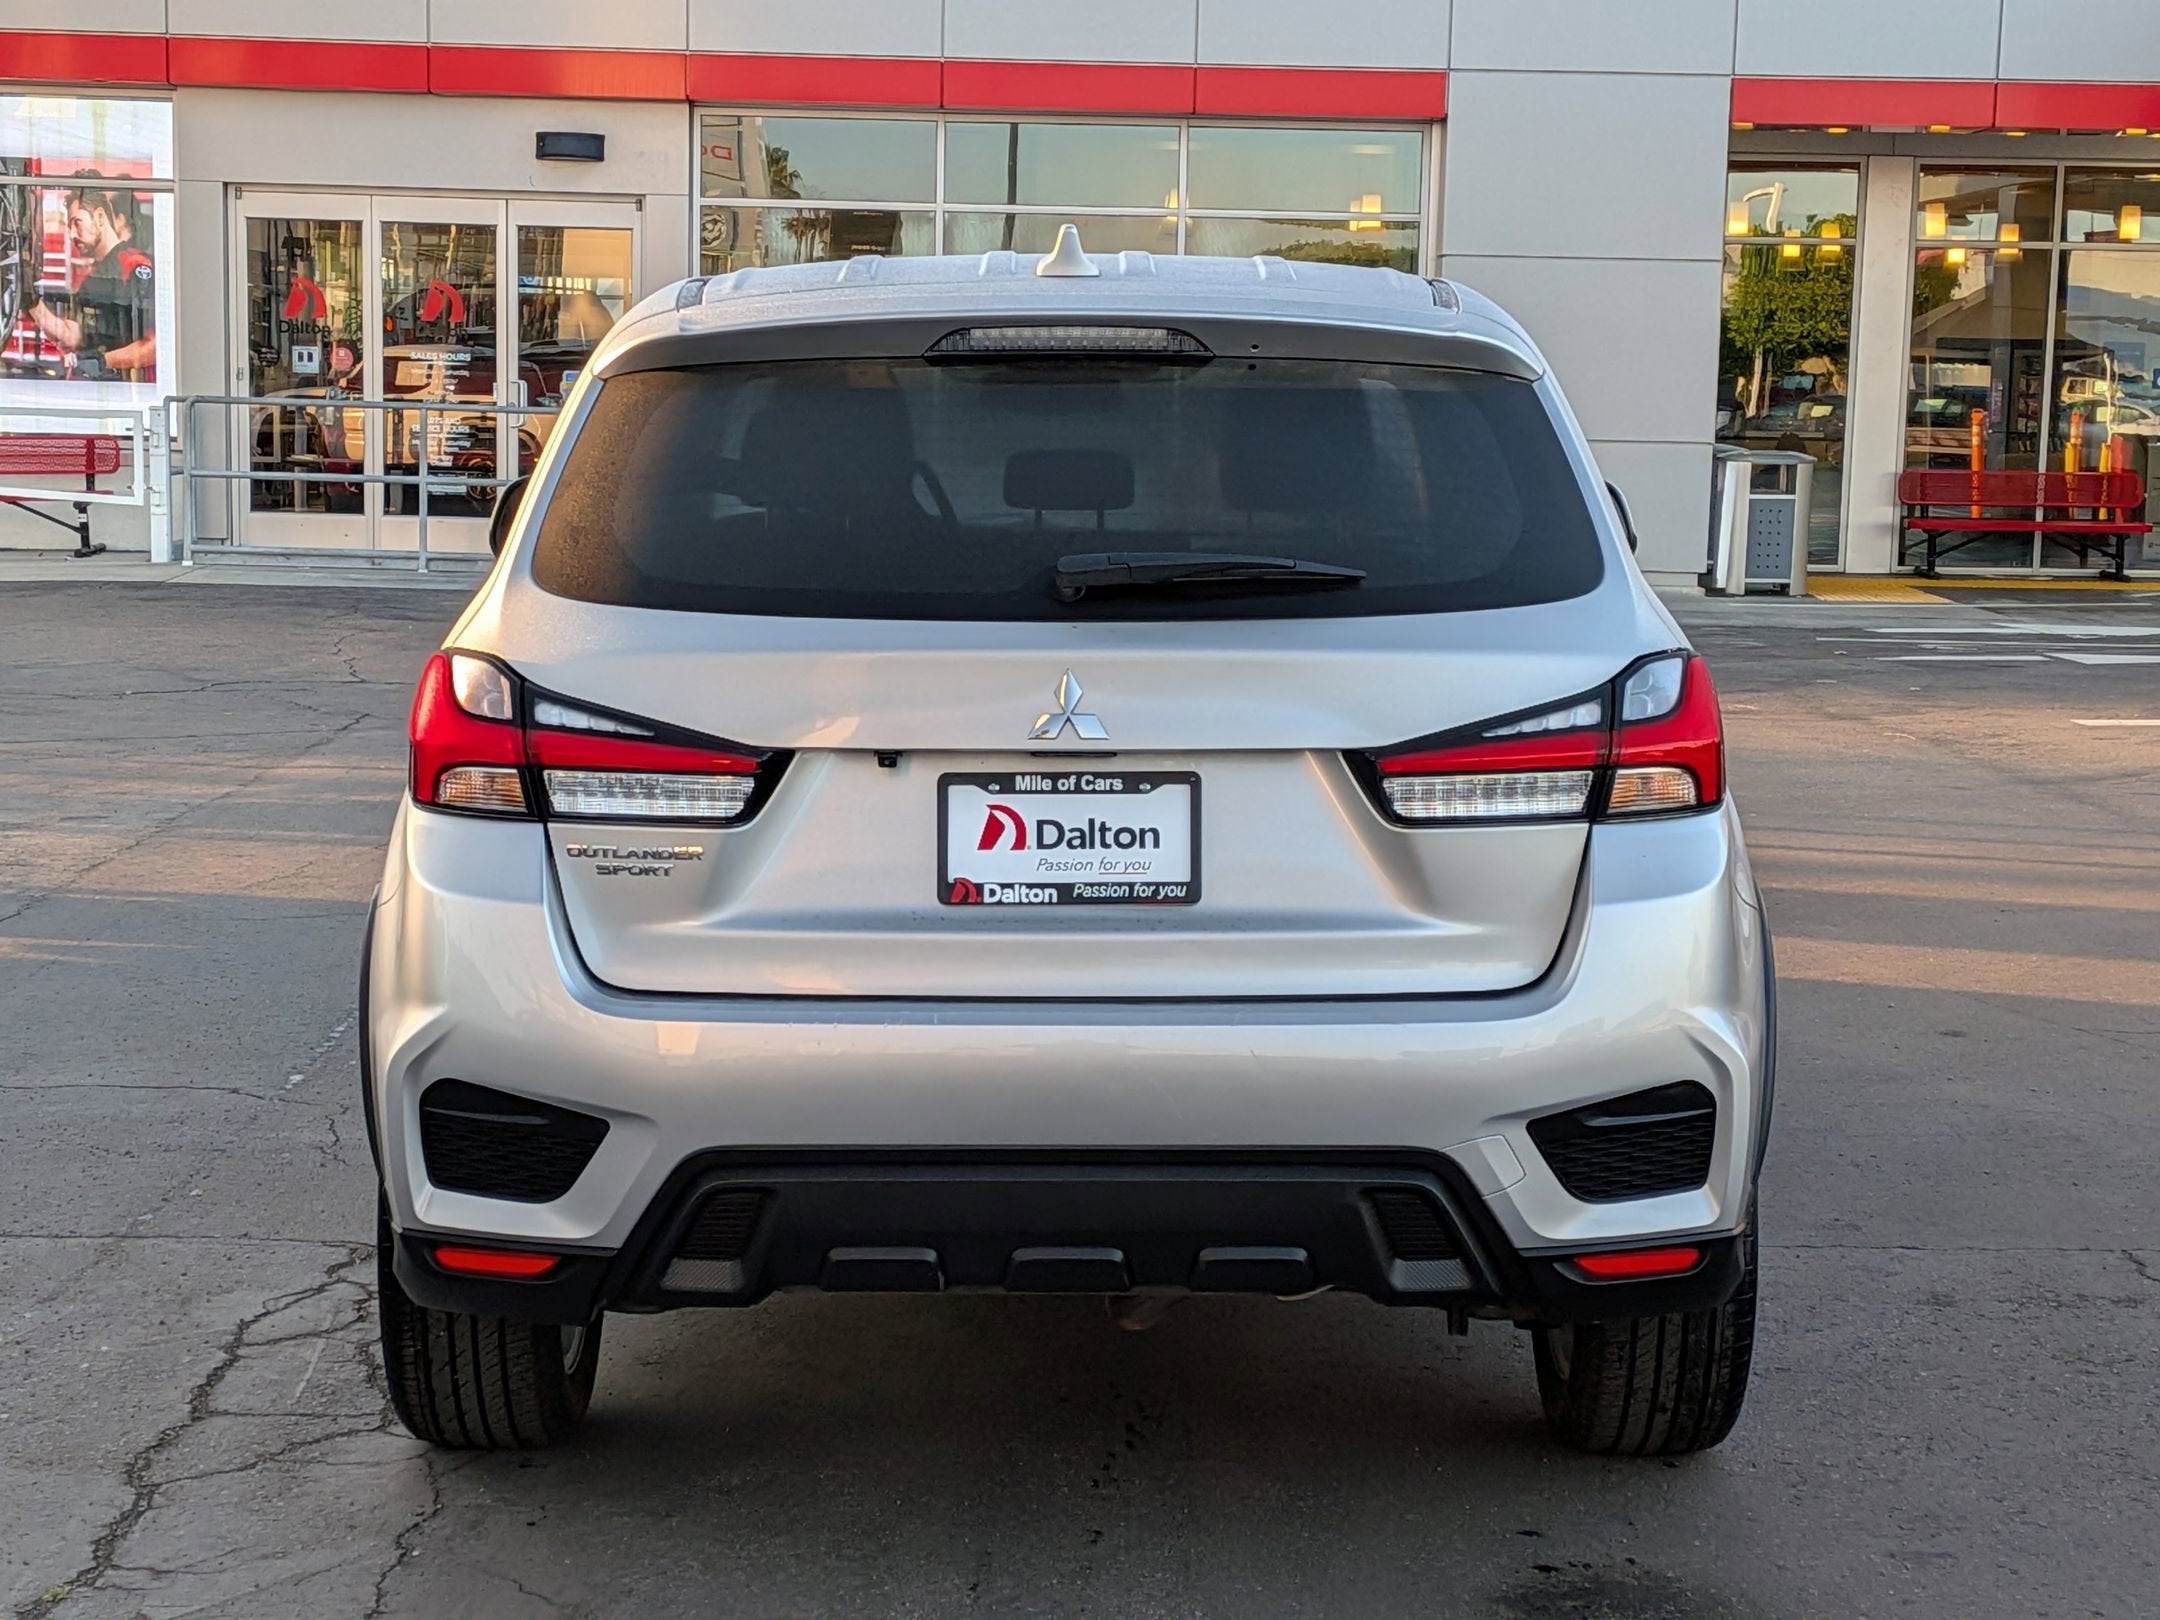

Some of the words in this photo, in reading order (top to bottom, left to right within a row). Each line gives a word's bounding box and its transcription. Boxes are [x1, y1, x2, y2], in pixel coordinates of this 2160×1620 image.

[280, 320, 331, 335] Dalton
[1015, 774, 1052, 791] Mile
[1057, 775, 1077, 791] of
[1080, 774, 1124, 791] Cars
[1036, 818, 1160, 850] Dalton
[566, 844, 704, 861] OUTLANDER
[595, 862, 675, 876] SPORT
[1036, 858, 1094, 872] Passion
[1098, 857, 1121, 872] for
[1123, 860, 1152, 874] you
[983, 883, 1058, 903] Dalton
[1073, 883, 1129, 898] Passion
[1133, 883, 1156, 898] for
[1156, 884, 1187, 900] you
